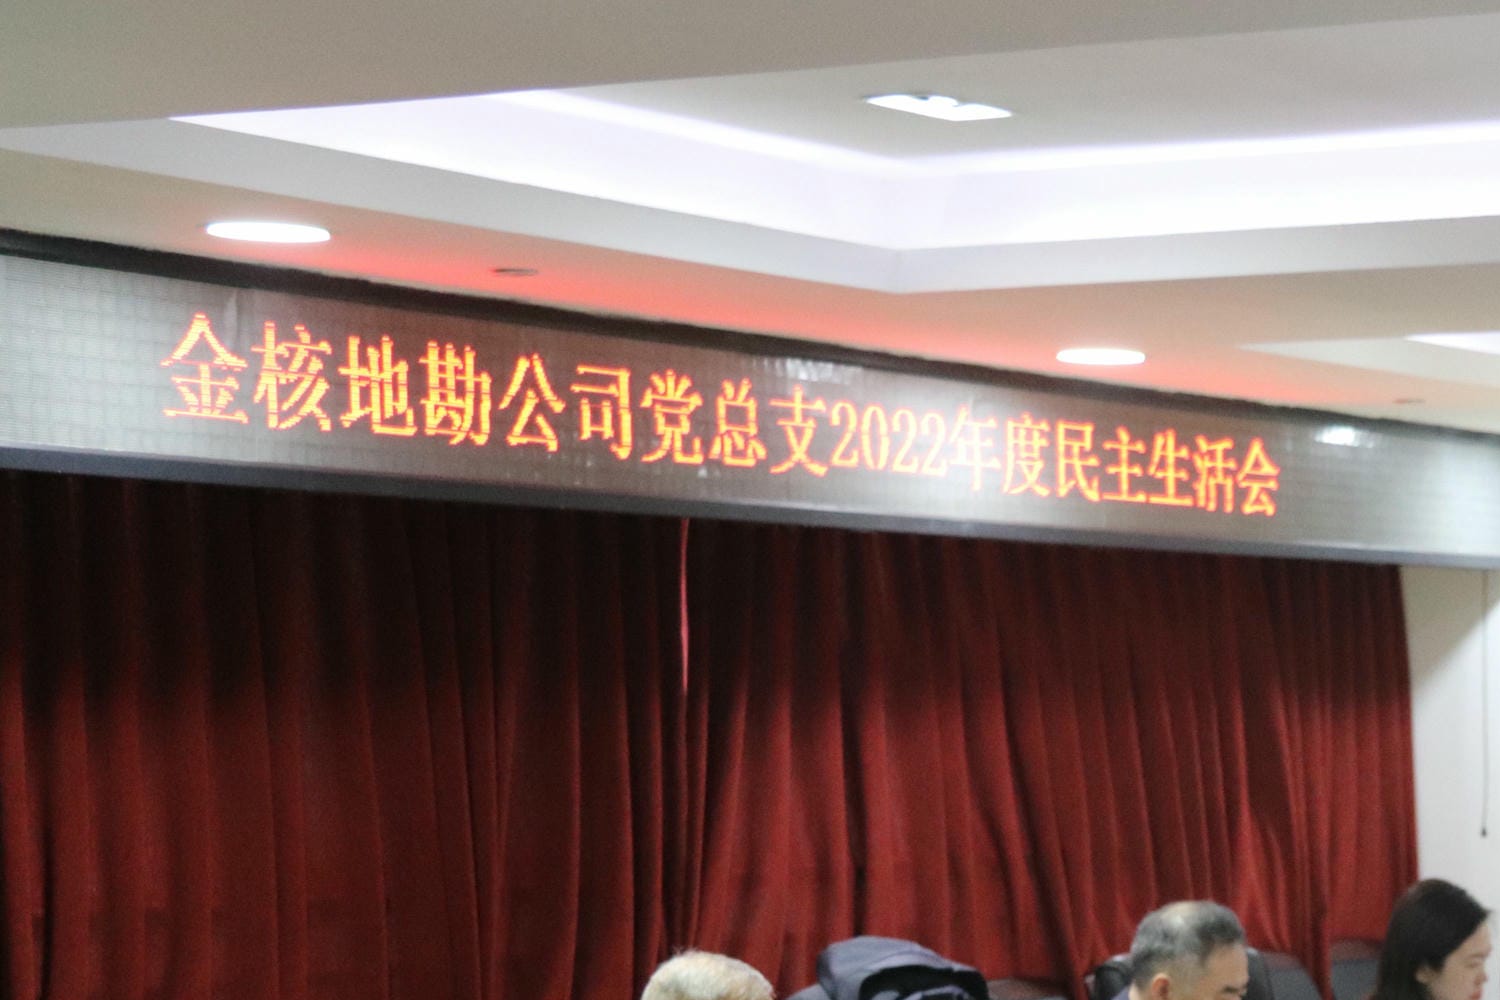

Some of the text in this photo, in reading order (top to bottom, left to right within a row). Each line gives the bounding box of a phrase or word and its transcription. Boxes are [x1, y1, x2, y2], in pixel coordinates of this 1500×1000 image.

[160, 311, 1281, 518] 金核地勘公司党总支2022年度民主生活会
